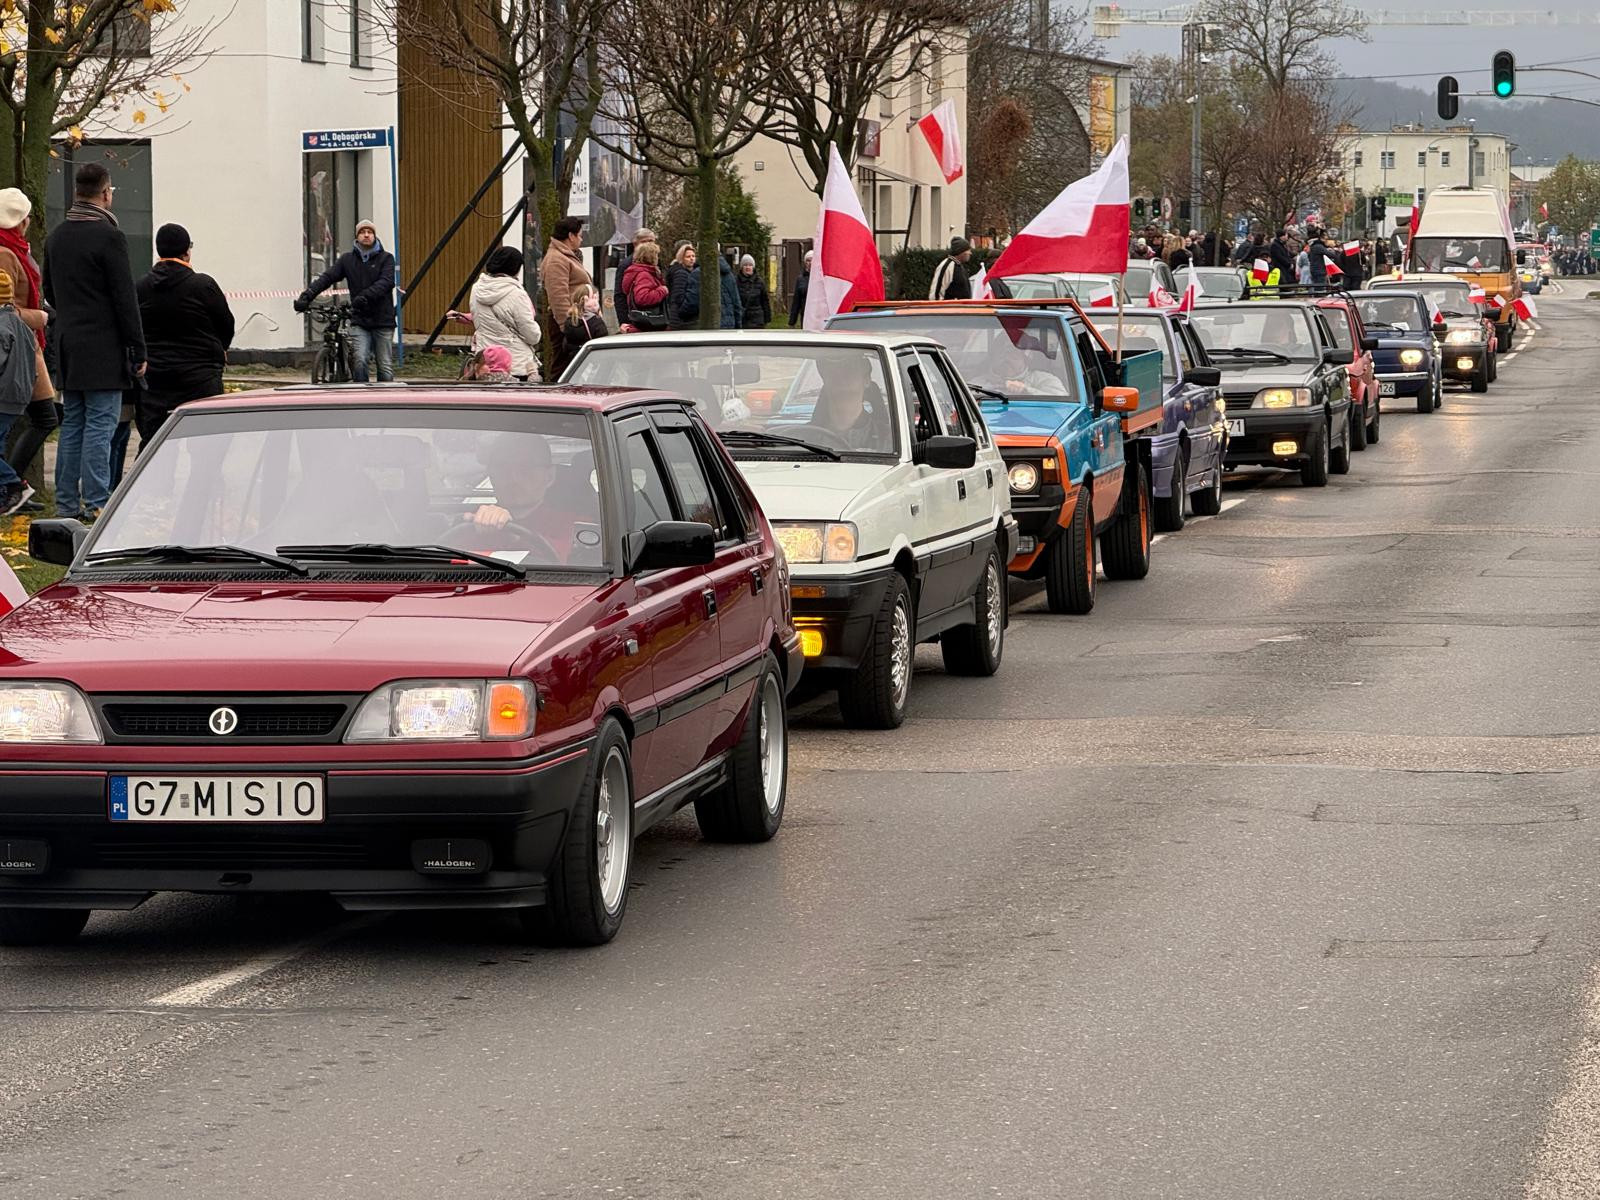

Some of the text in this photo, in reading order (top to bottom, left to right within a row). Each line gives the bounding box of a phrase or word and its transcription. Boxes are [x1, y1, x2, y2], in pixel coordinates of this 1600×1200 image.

[320, 133, 331, 142] ul.
[134, 781, 315, 816] G7 MISIO
[113, 803, 126, 813] PL
